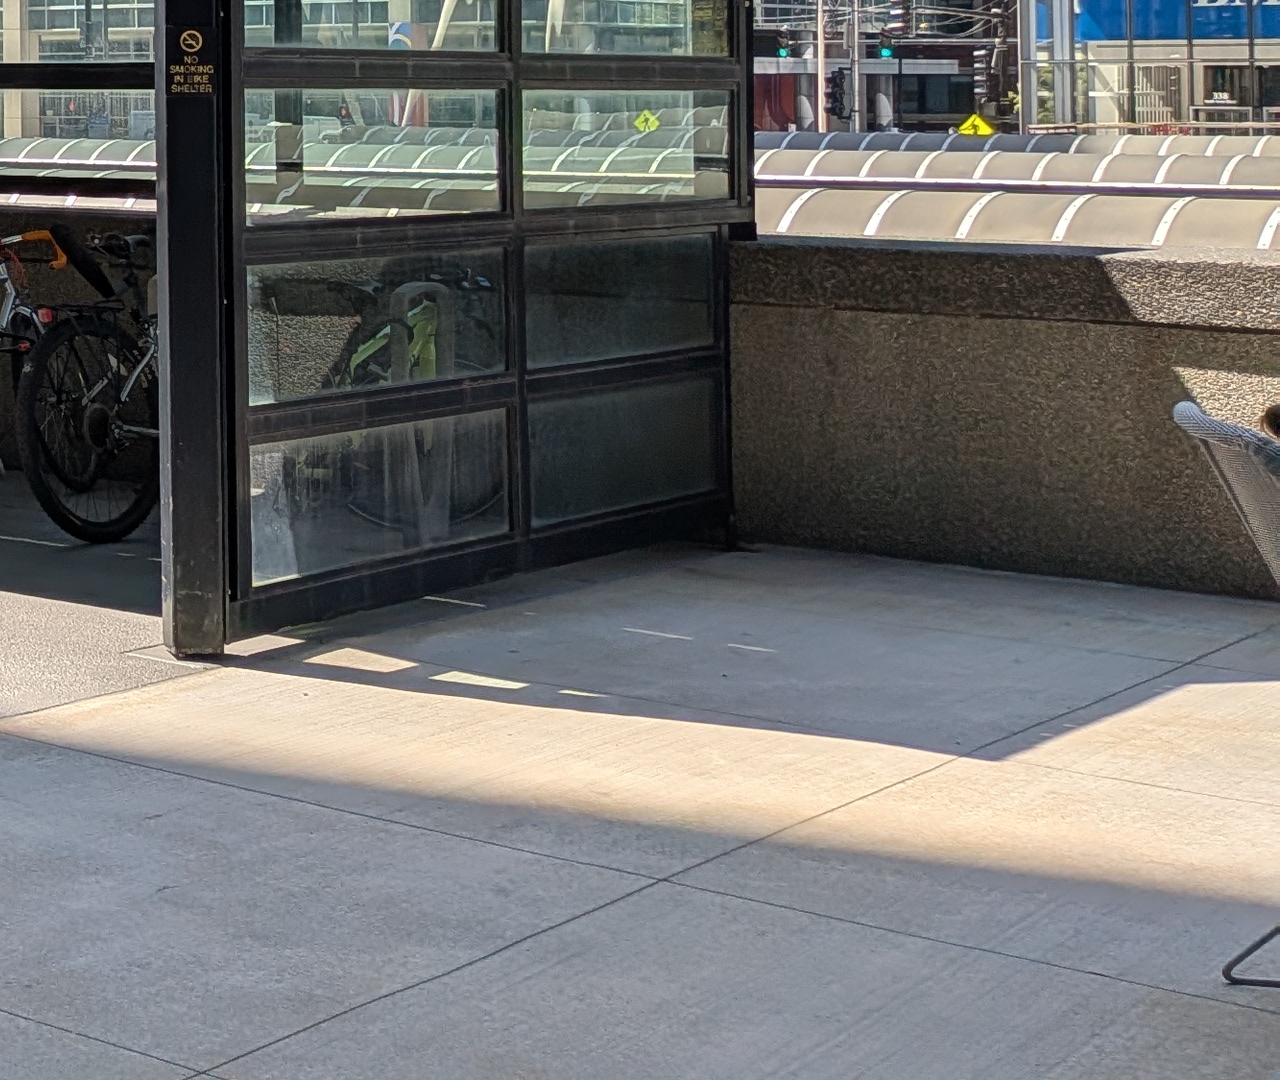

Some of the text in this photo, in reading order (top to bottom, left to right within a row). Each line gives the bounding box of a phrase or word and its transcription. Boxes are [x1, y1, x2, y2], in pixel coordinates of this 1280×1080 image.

[183, 55, 199, 64] NO
[169, 65, 214, 74] SMOKING
[173, 74, 209, 83] IN BIKE
[170, 84, 213, 93] SHELTER
